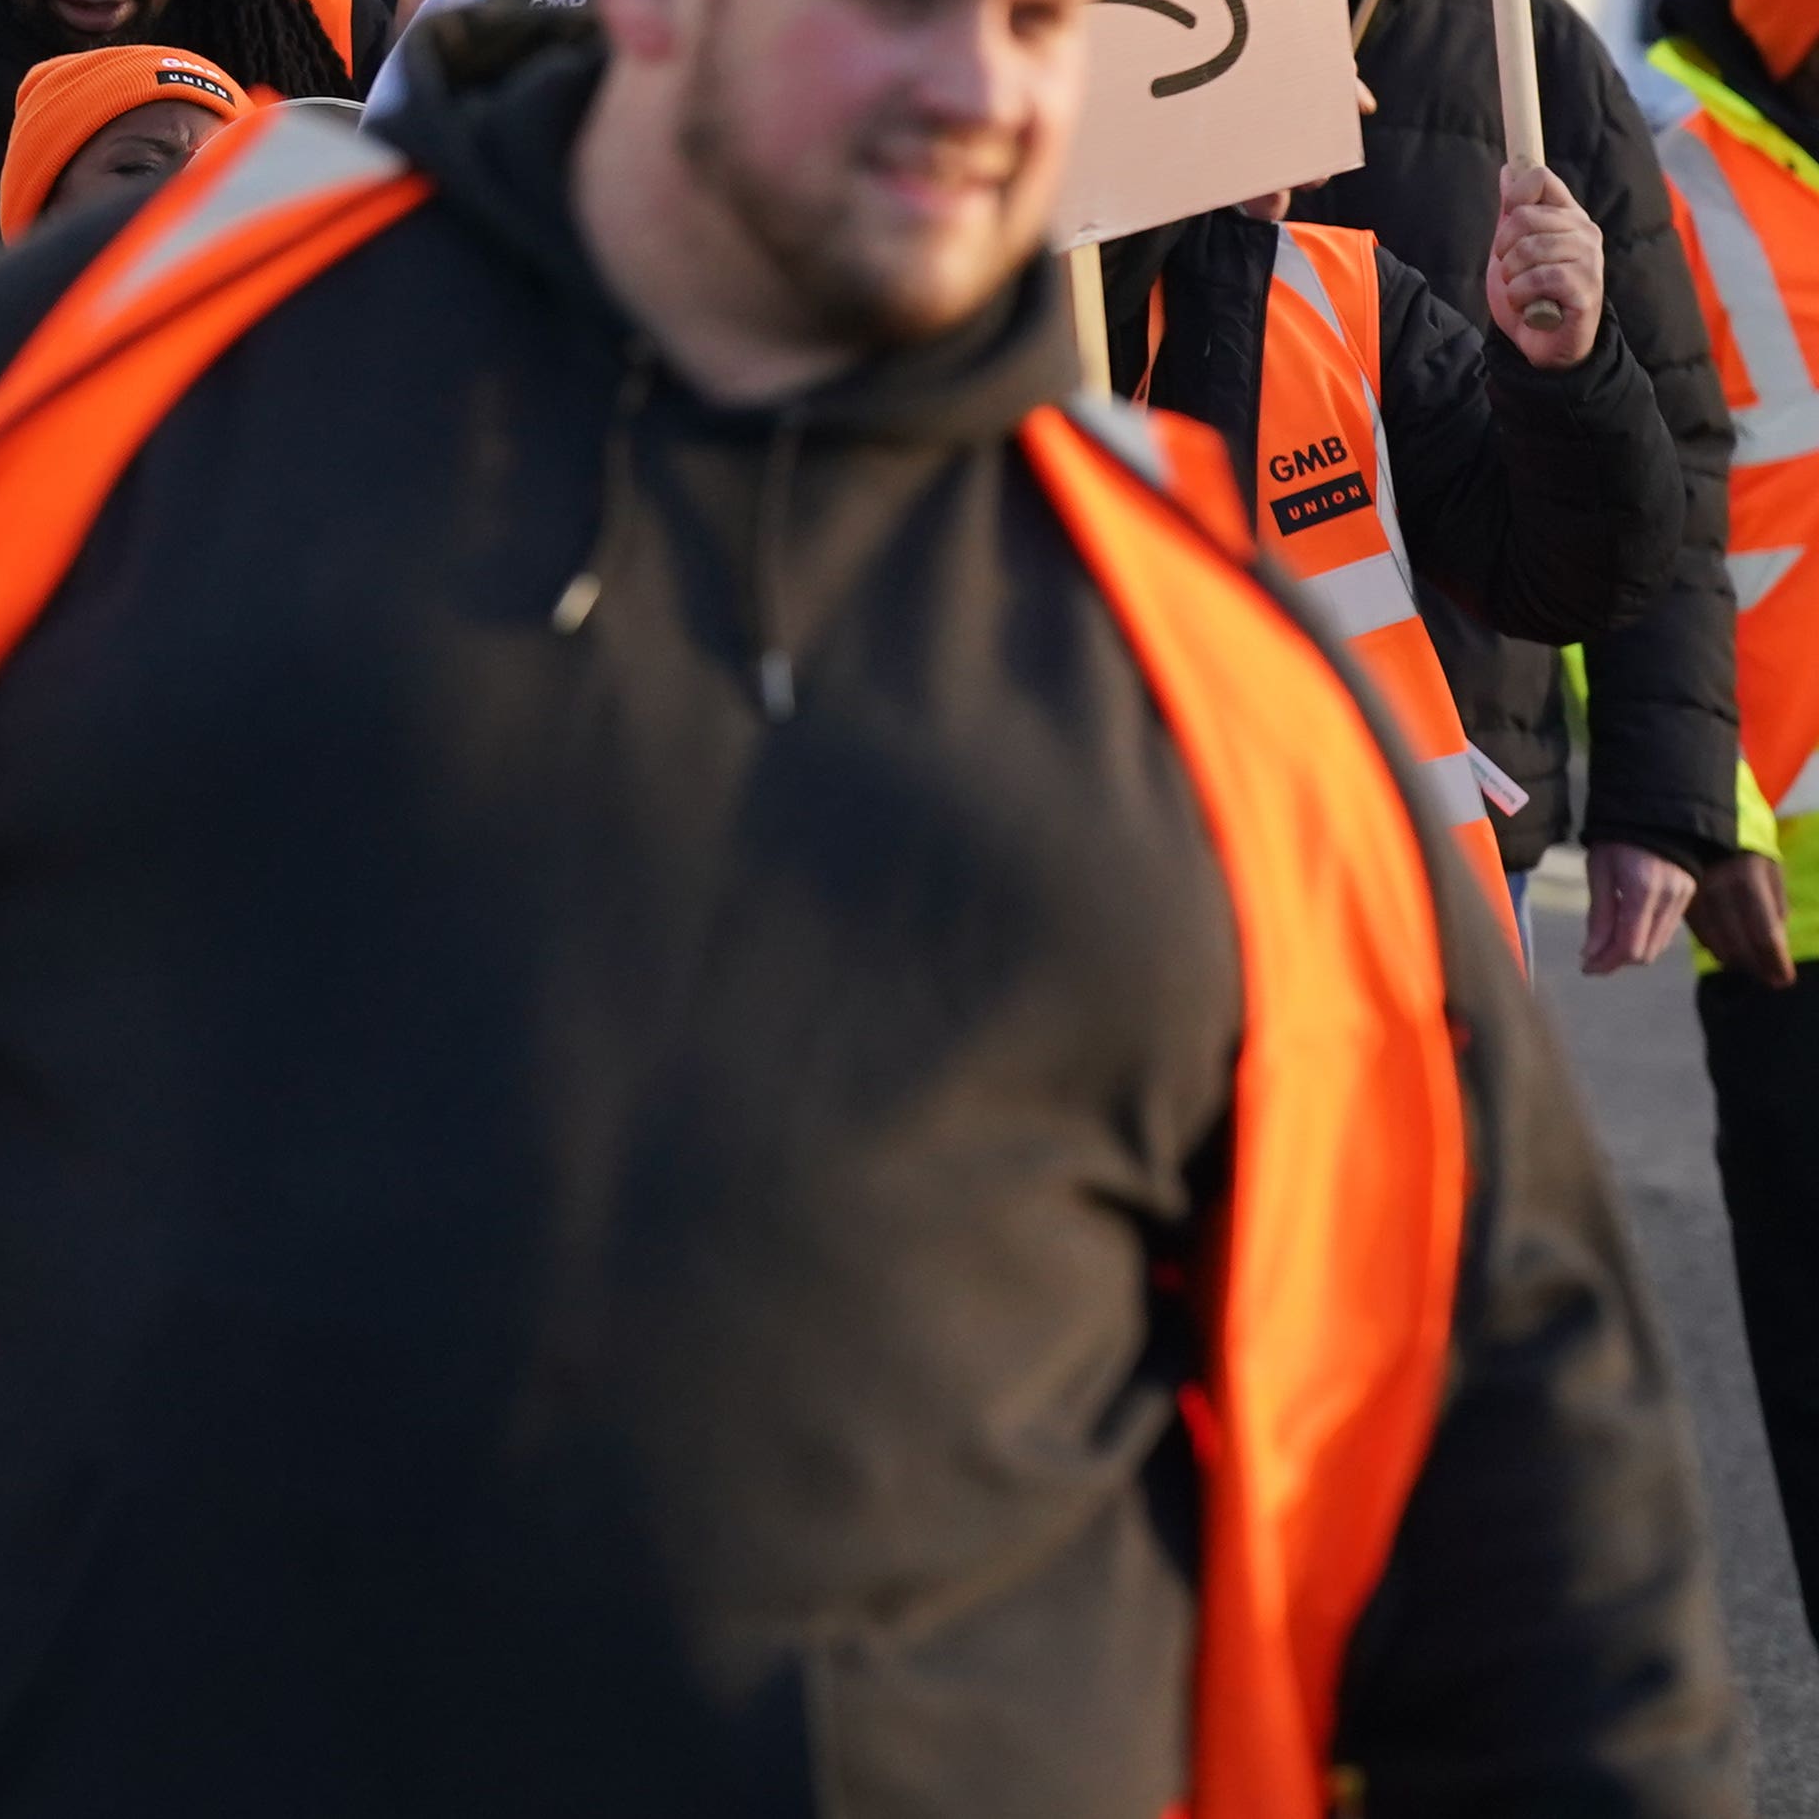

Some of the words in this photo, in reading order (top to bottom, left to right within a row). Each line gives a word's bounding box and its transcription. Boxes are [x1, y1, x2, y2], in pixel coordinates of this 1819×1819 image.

[168, 71, 228, 99] UNION
[1269, 435, 1348, 483] GMB
[1288, 484, 1362, 521] UNION
